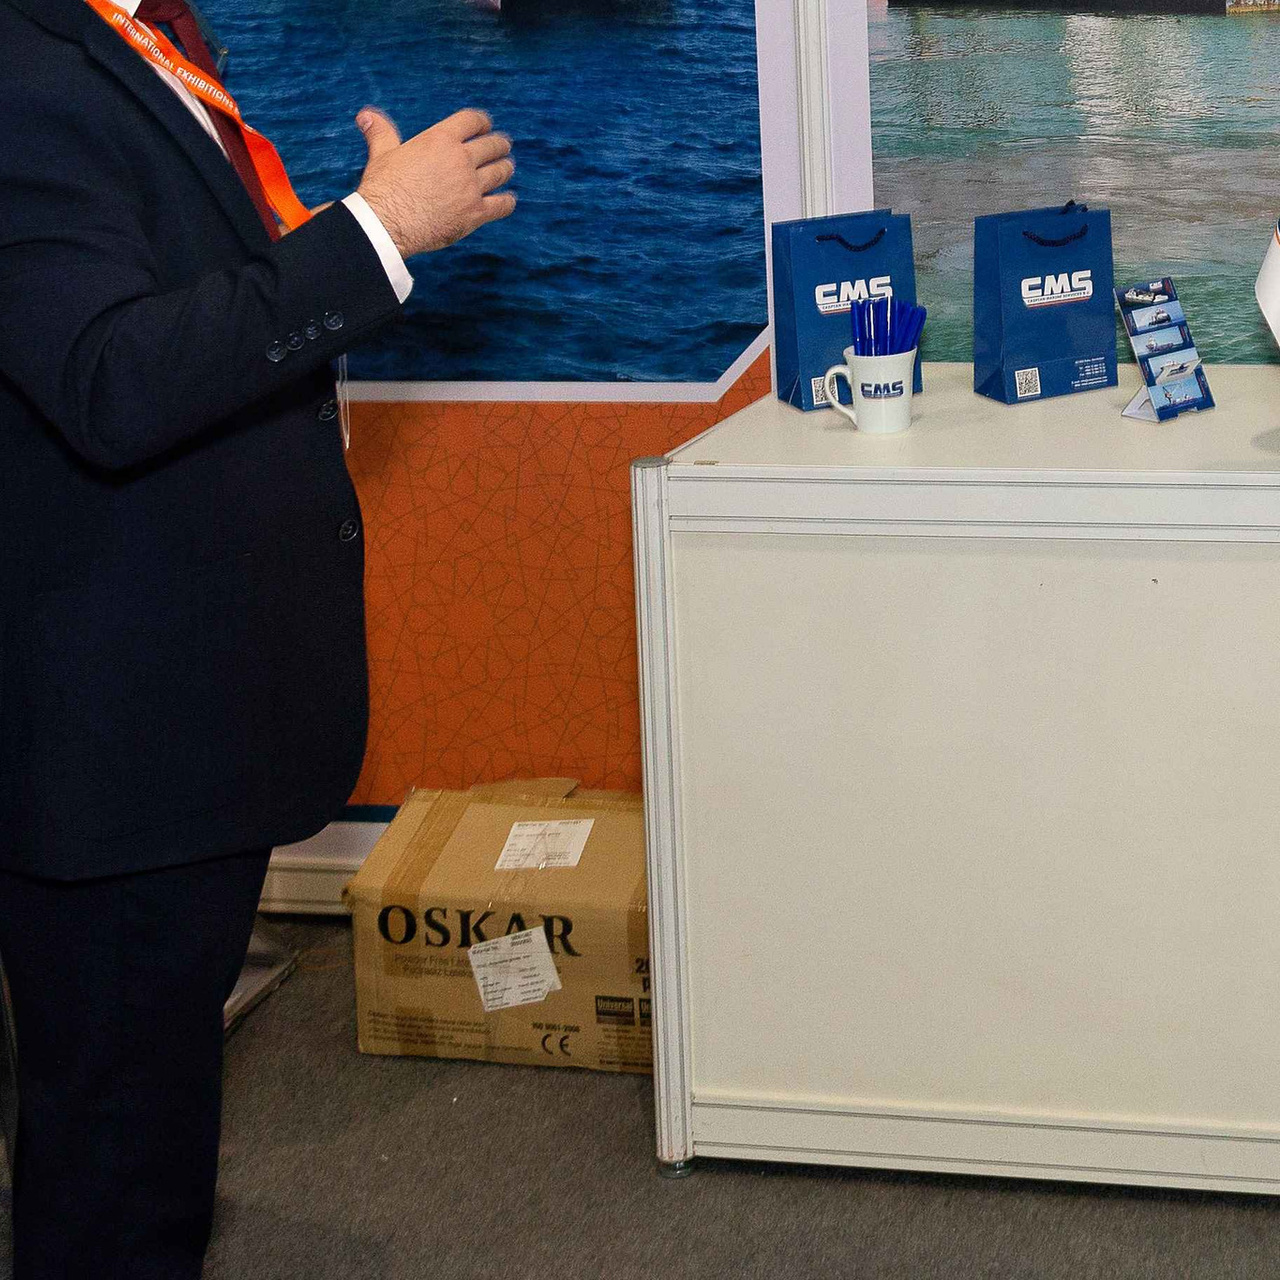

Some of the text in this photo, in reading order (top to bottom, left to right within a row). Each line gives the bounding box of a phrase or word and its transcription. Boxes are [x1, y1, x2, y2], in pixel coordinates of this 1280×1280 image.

[113, 12, 235, 111] INTERNATIONAL EXHIBITIONS
[814, 275, 893, 304] CMS
[1021, 270, 1093, 297] CMS
[861, 380, 904, 398] CMS
